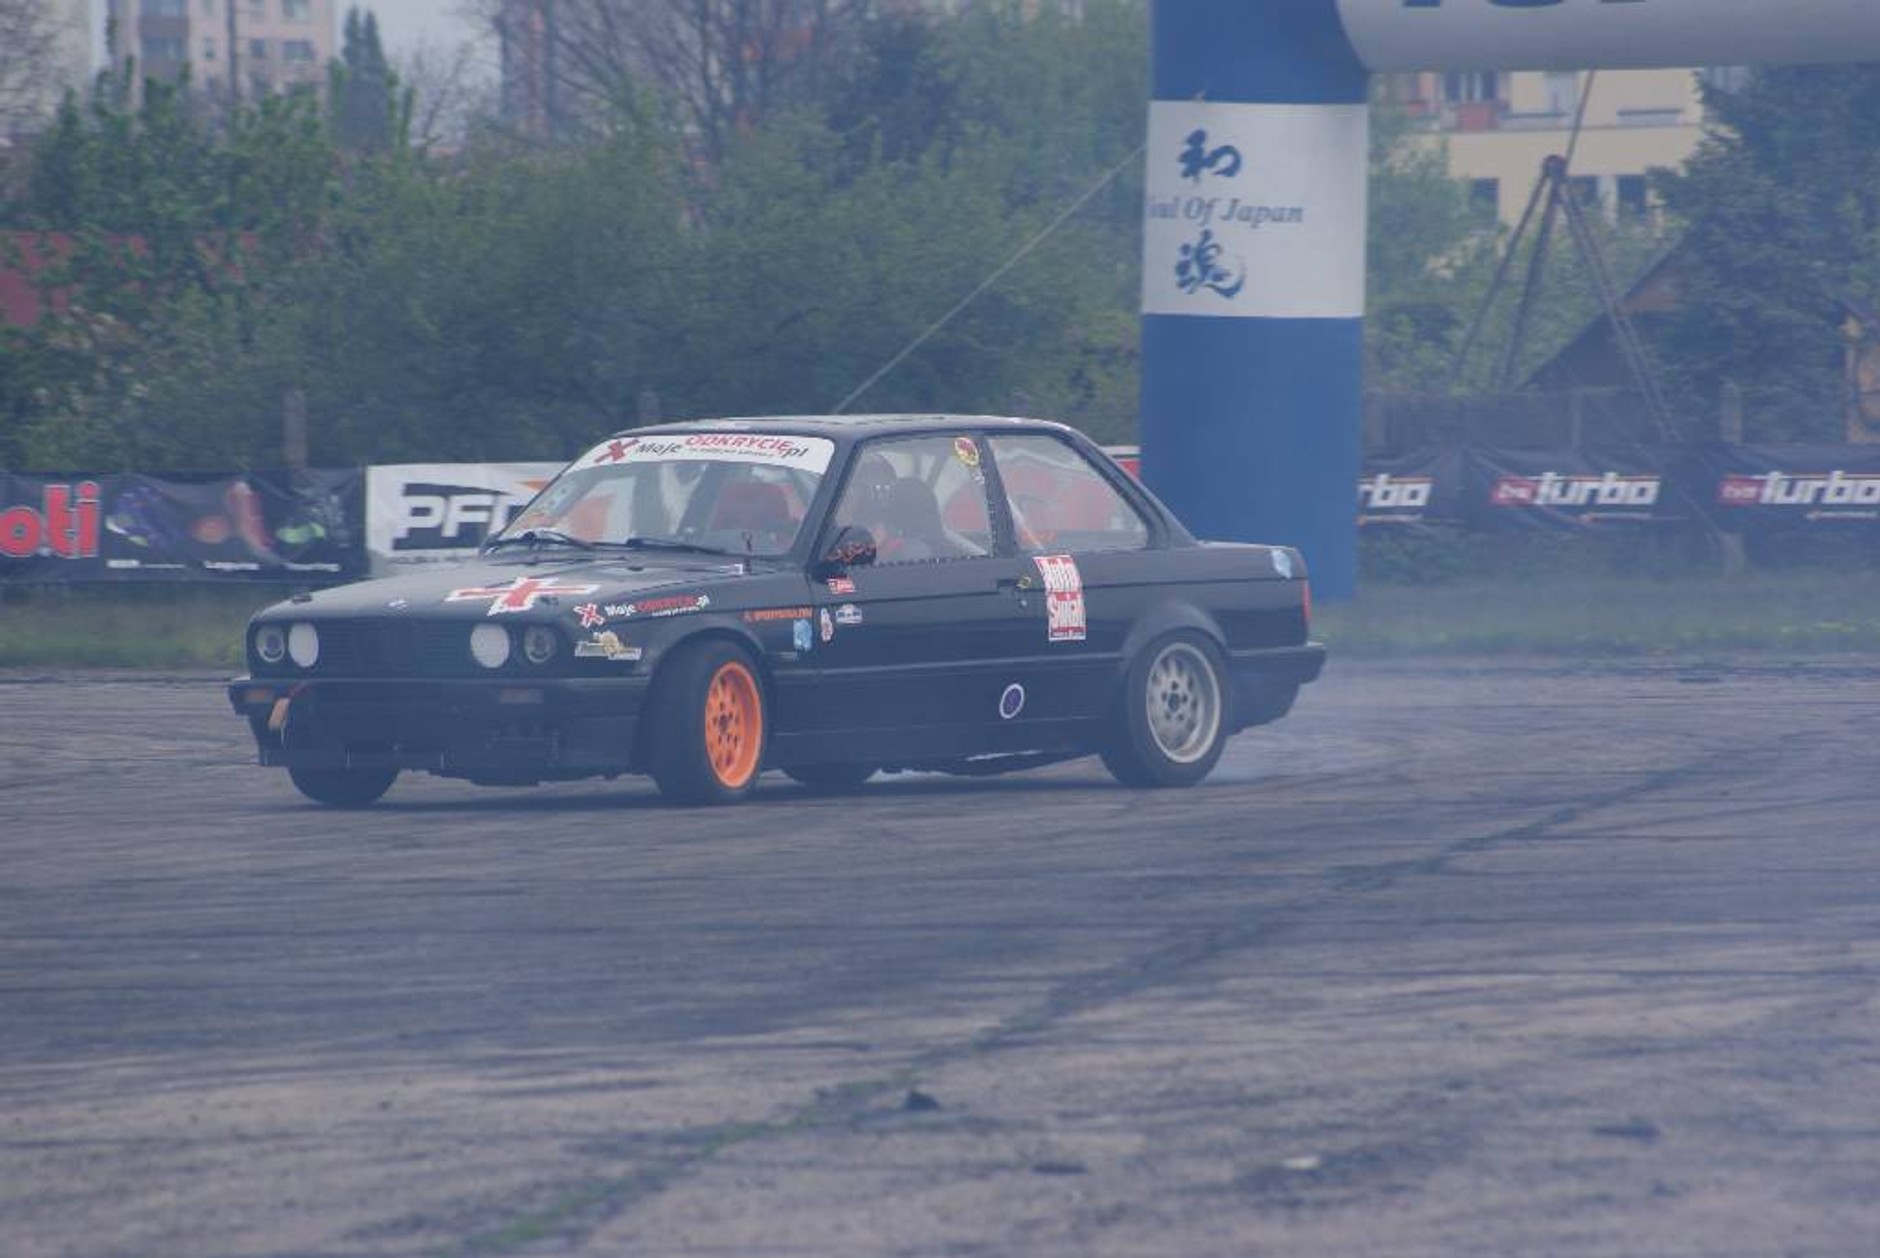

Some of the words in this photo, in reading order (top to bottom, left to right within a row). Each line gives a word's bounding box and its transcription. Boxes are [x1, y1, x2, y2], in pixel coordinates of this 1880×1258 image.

[1183, 197, 1219, 226] Of
[1220, 198, 1304, 229] Japan
[1535, 471, 1661, 505] turbo
